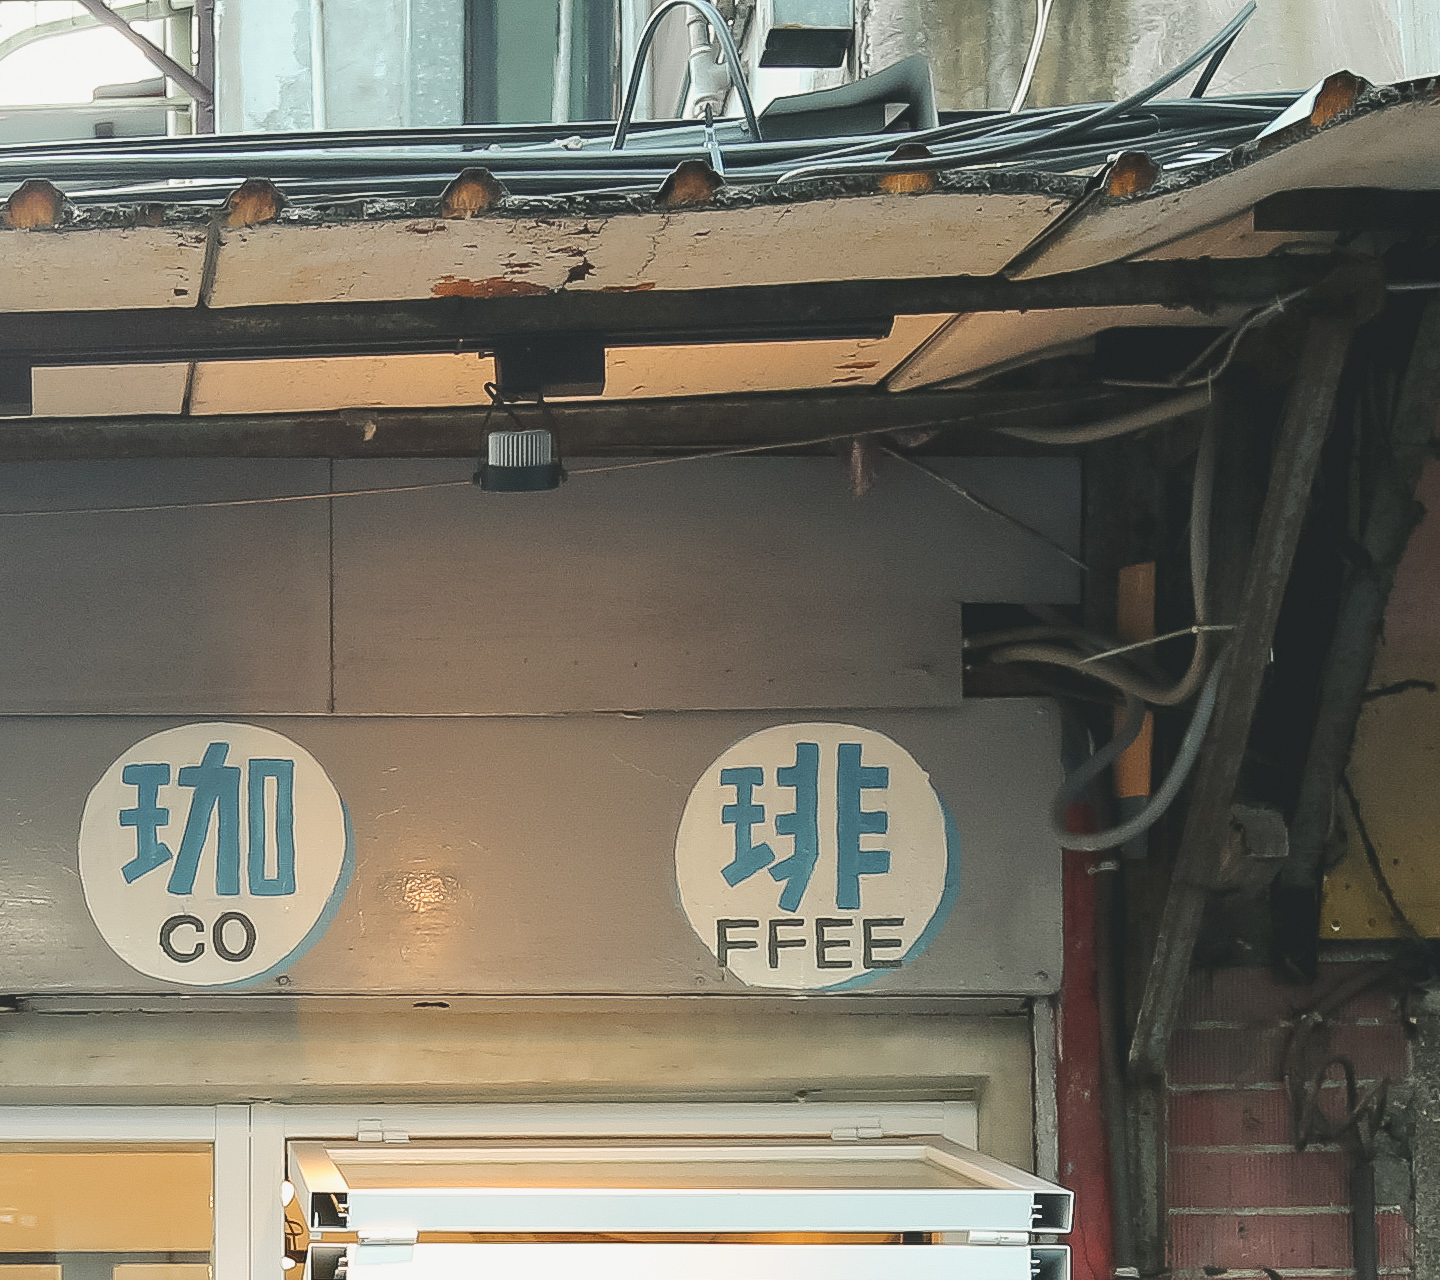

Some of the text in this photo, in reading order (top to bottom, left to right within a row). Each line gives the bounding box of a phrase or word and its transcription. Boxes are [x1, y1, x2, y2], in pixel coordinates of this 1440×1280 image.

[119, 741, 298, 898] 珈
[158, 911, 257, 964] CO
[715, 918, 906, 970] FFEE
